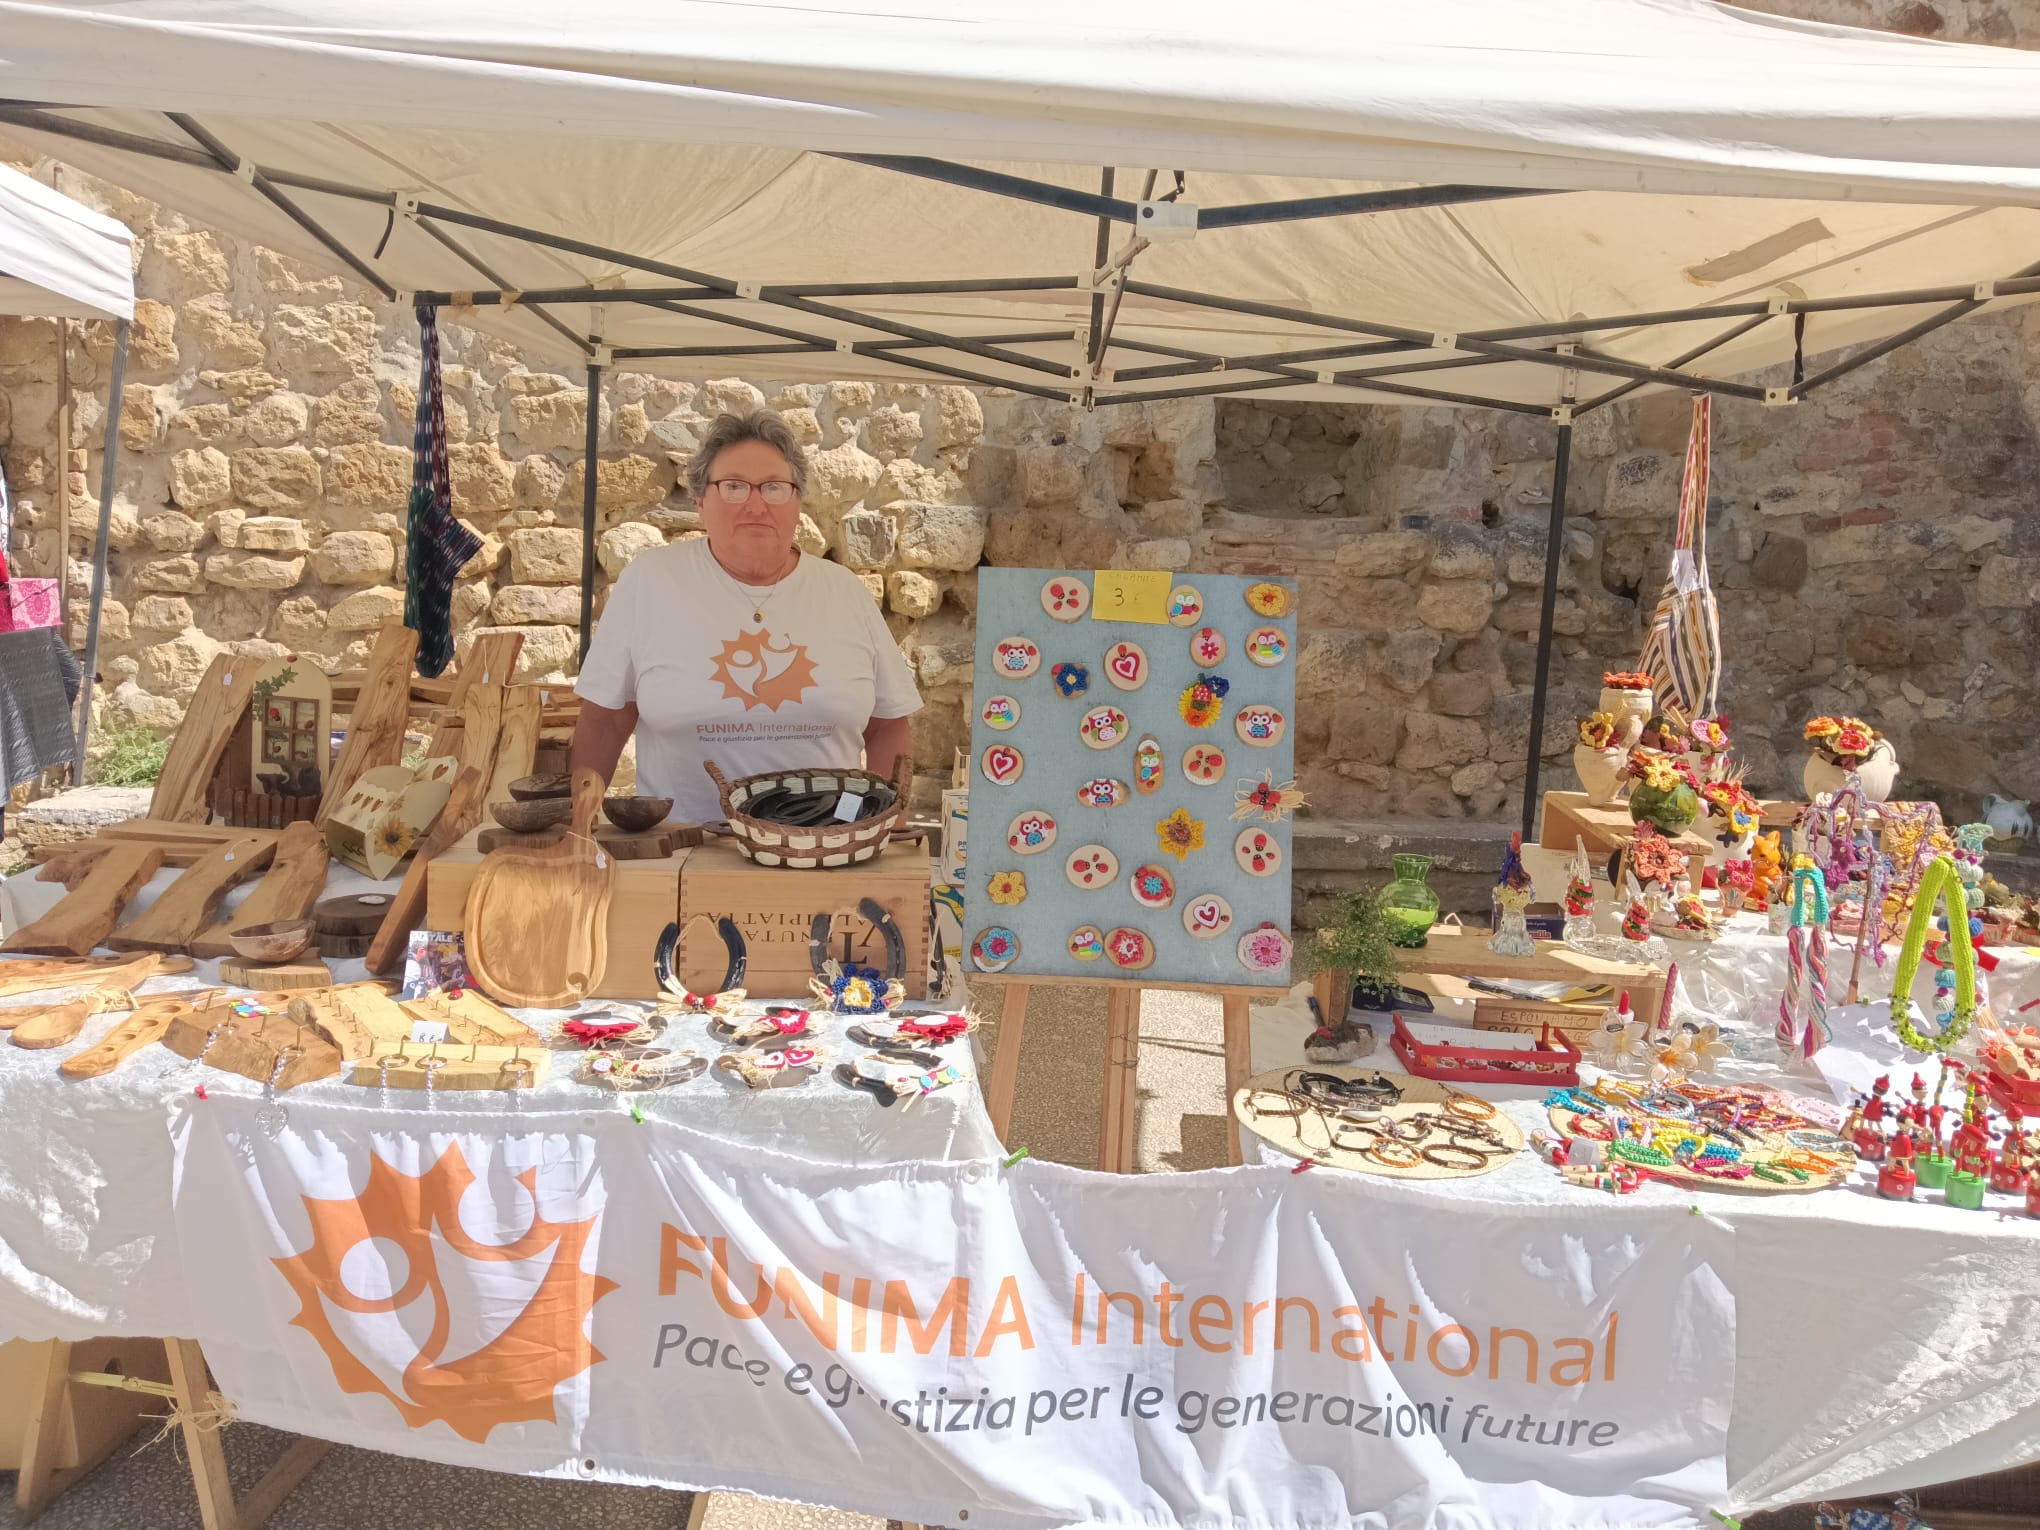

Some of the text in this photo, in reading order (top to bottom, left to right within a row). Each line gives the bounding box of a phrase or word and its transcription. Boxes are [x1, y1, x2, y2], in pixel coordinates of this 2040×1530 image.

[1114, 587, 1125, 607] 3
[696, 722, 754, 733] FUNIMA
[658, 1222, 1618, 1386] FUNIMA International
[653, 1323, 770, 1386] Pace
[784, 1363, 813, 1396] e
[1025, 1385, 1110, 1436] per
[1121, 1373, 1164, 1420] le
[1175, 1387, 1454, 1438] generazioni
[1461, 1402, 1620, 1447] future
